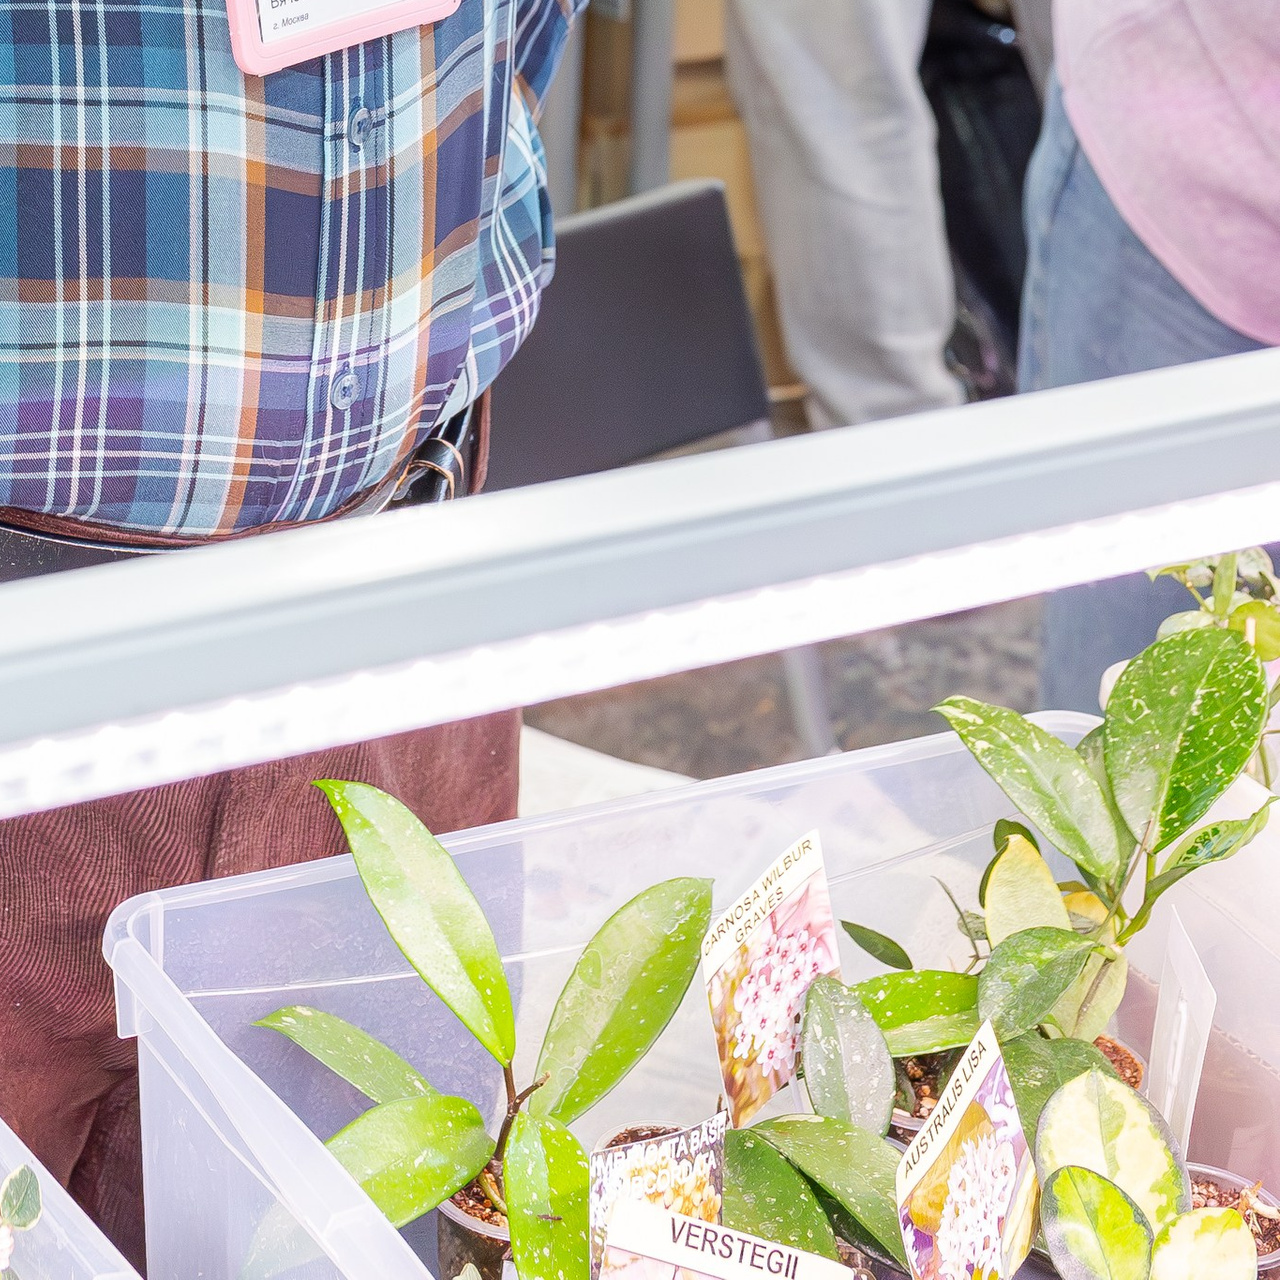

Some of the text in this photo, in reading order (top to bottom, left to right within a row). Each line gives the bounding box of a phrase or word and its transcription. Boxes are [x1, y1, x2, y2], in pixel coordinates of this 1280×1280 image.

[281, 12, 310, 28] Москва
[704, 839, 813, 957] CARNOSA WILBUR
[735, 886, 784, 944] GRAVES
[904, 1040, 988, 1180] AUSTRALIS LISA
[669, 1216, 800, 1280] VERSTEGII
